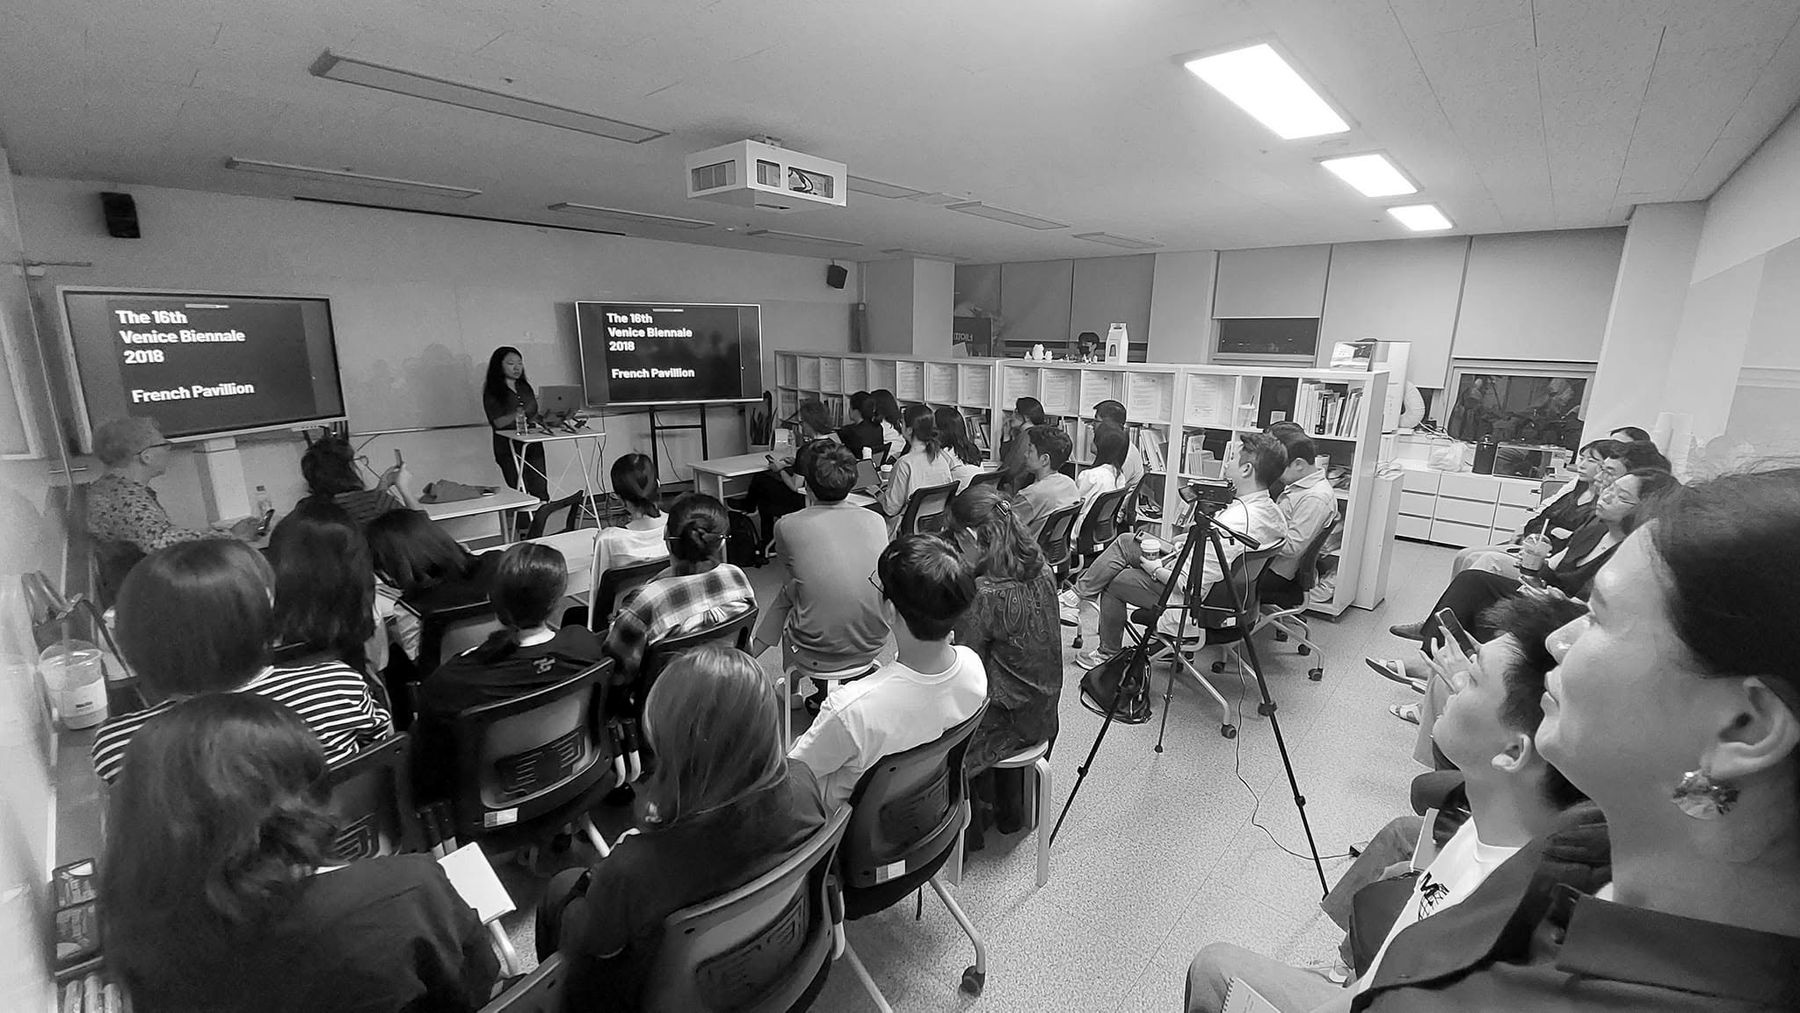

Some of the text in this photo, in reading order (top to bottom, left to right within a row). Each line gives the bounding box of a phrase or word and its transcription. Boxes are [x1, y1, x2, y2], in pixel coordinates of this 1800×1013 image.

[115, 310, 189, 324] The 16th
[606, 313, 653, 324] The 16th
[119, 329, 246, 344] Venice Biennale
[607, 327, 693, 338] Venice Biennale
[609, 341, 636, 351] 2018
[123, 349, 165, 364] 2018
[611, 367, 695, 379] French Pavillion
[131, 382, 255, 403] French Pavillion
